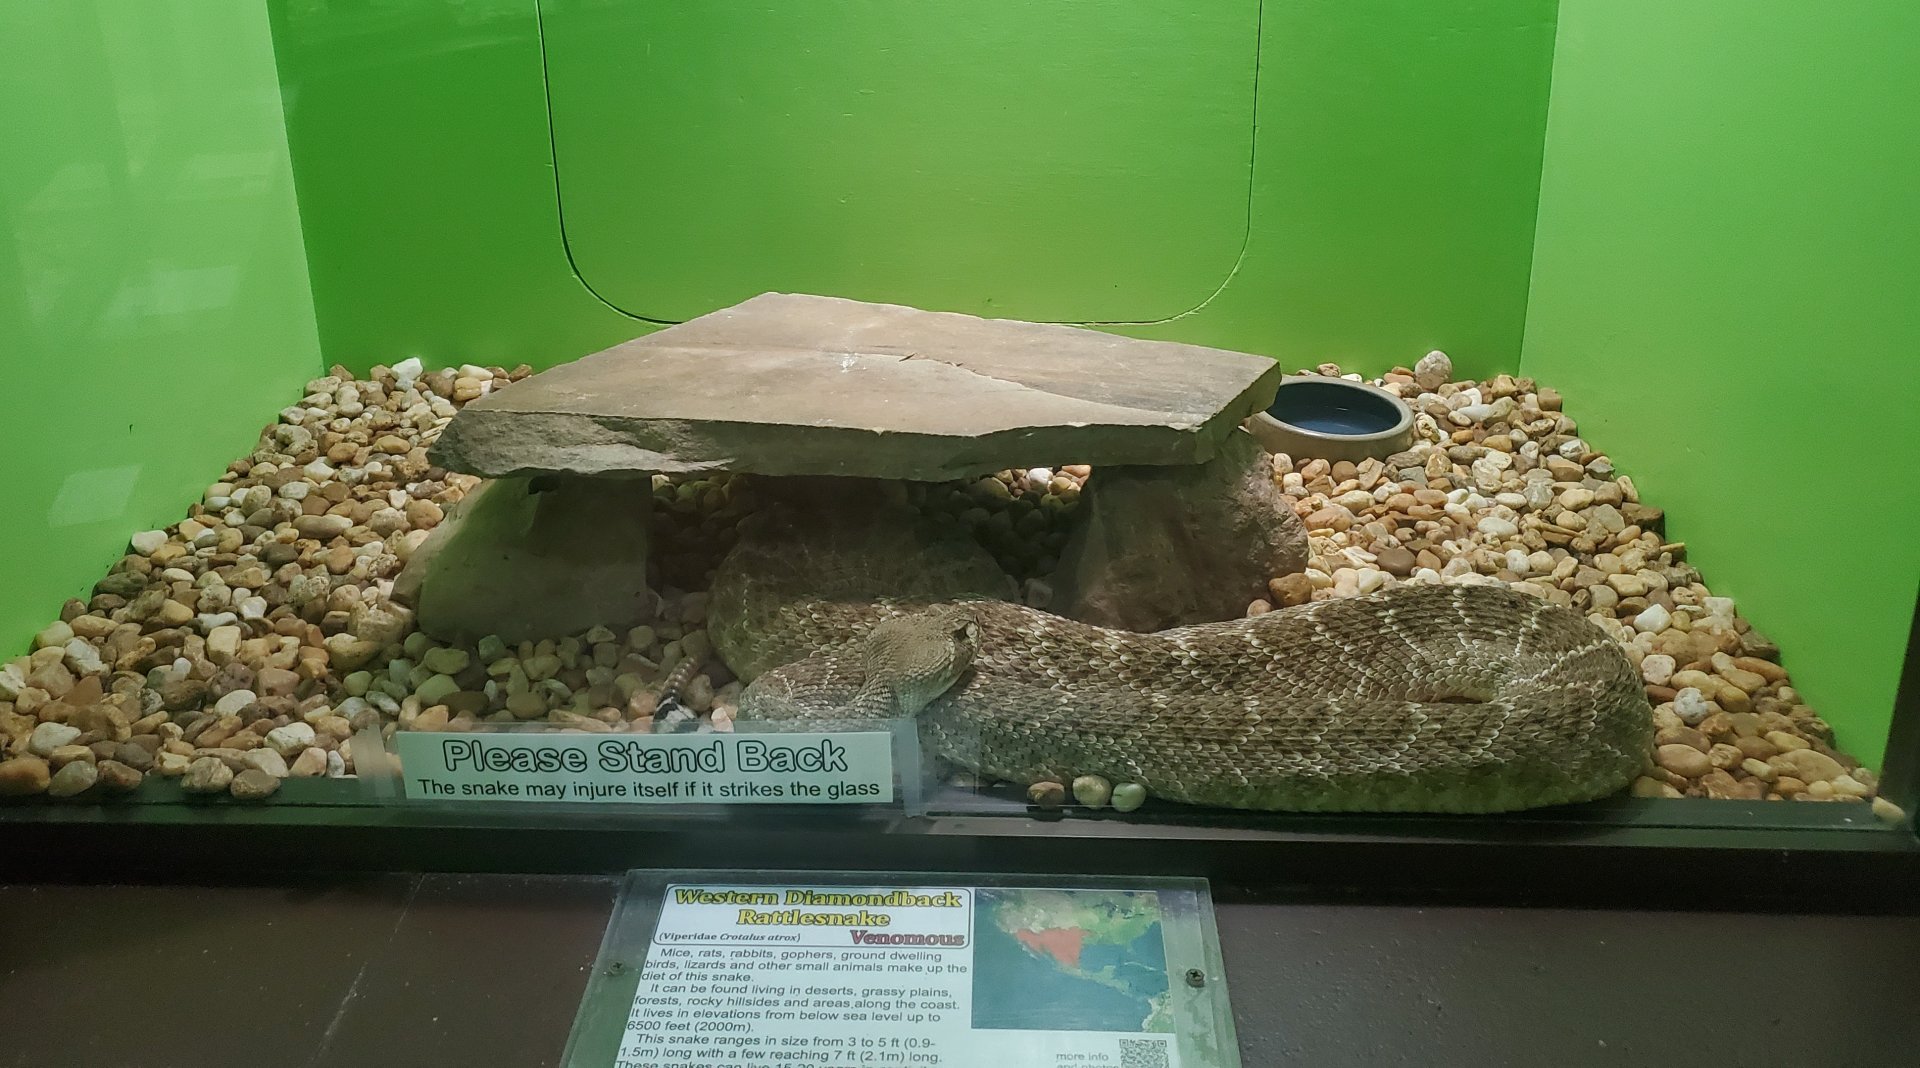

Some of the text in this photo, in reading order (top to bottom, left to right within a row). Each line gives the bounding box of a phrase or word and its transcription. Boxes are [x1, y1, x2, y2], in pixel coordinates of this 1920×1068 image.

[443, 739, 848, 774] Please Stand Back
[418, 779, 879, 800] The snake may injure itself if it strikes the glass
[675, 888, 962, 907] Western Diamondback
[736, 909, 890, 927] Rattlesnake
[659, 932, 801, 943] (Viperidae Crotalus atrox)
[850, 930, 964, 946] Venomous
[660, 948, 941, 963] Mice, rats, rabbits, gophers, ground dwelling
[645, 960, 967, 975] birds, lizards and other small animals make up the
[641, 972, 754, 982] diet of this snake.
[651, 984, 658, 993] It
[690, 985, 706, 993] be
[711, 985, 747, 994] found
[752, 985, 785, 996] living
[789, 986, 800, 995] in
[805, 986, 857, 997] deserts,
[861, 988, 905, 998] grassy
[910, 988, 951, 998] plains,
[634, 996, 960, 1010] forests, rocky hillsides and areas along the coast.
[631, 1008, 941, 1023] It lives in elevations from below sea level up to
[627, 1021, 754, 1033] 6500 feet (2000m).
[637, 1034, 936, 1050] This snake ranges in size from 3 to 5 ft (0.9-
[621, 1047, 942, 1064] 1.5m) long with a few reaching 7 ft (2.1m) long.
[1056, 1052, 1109, 1061] more info
